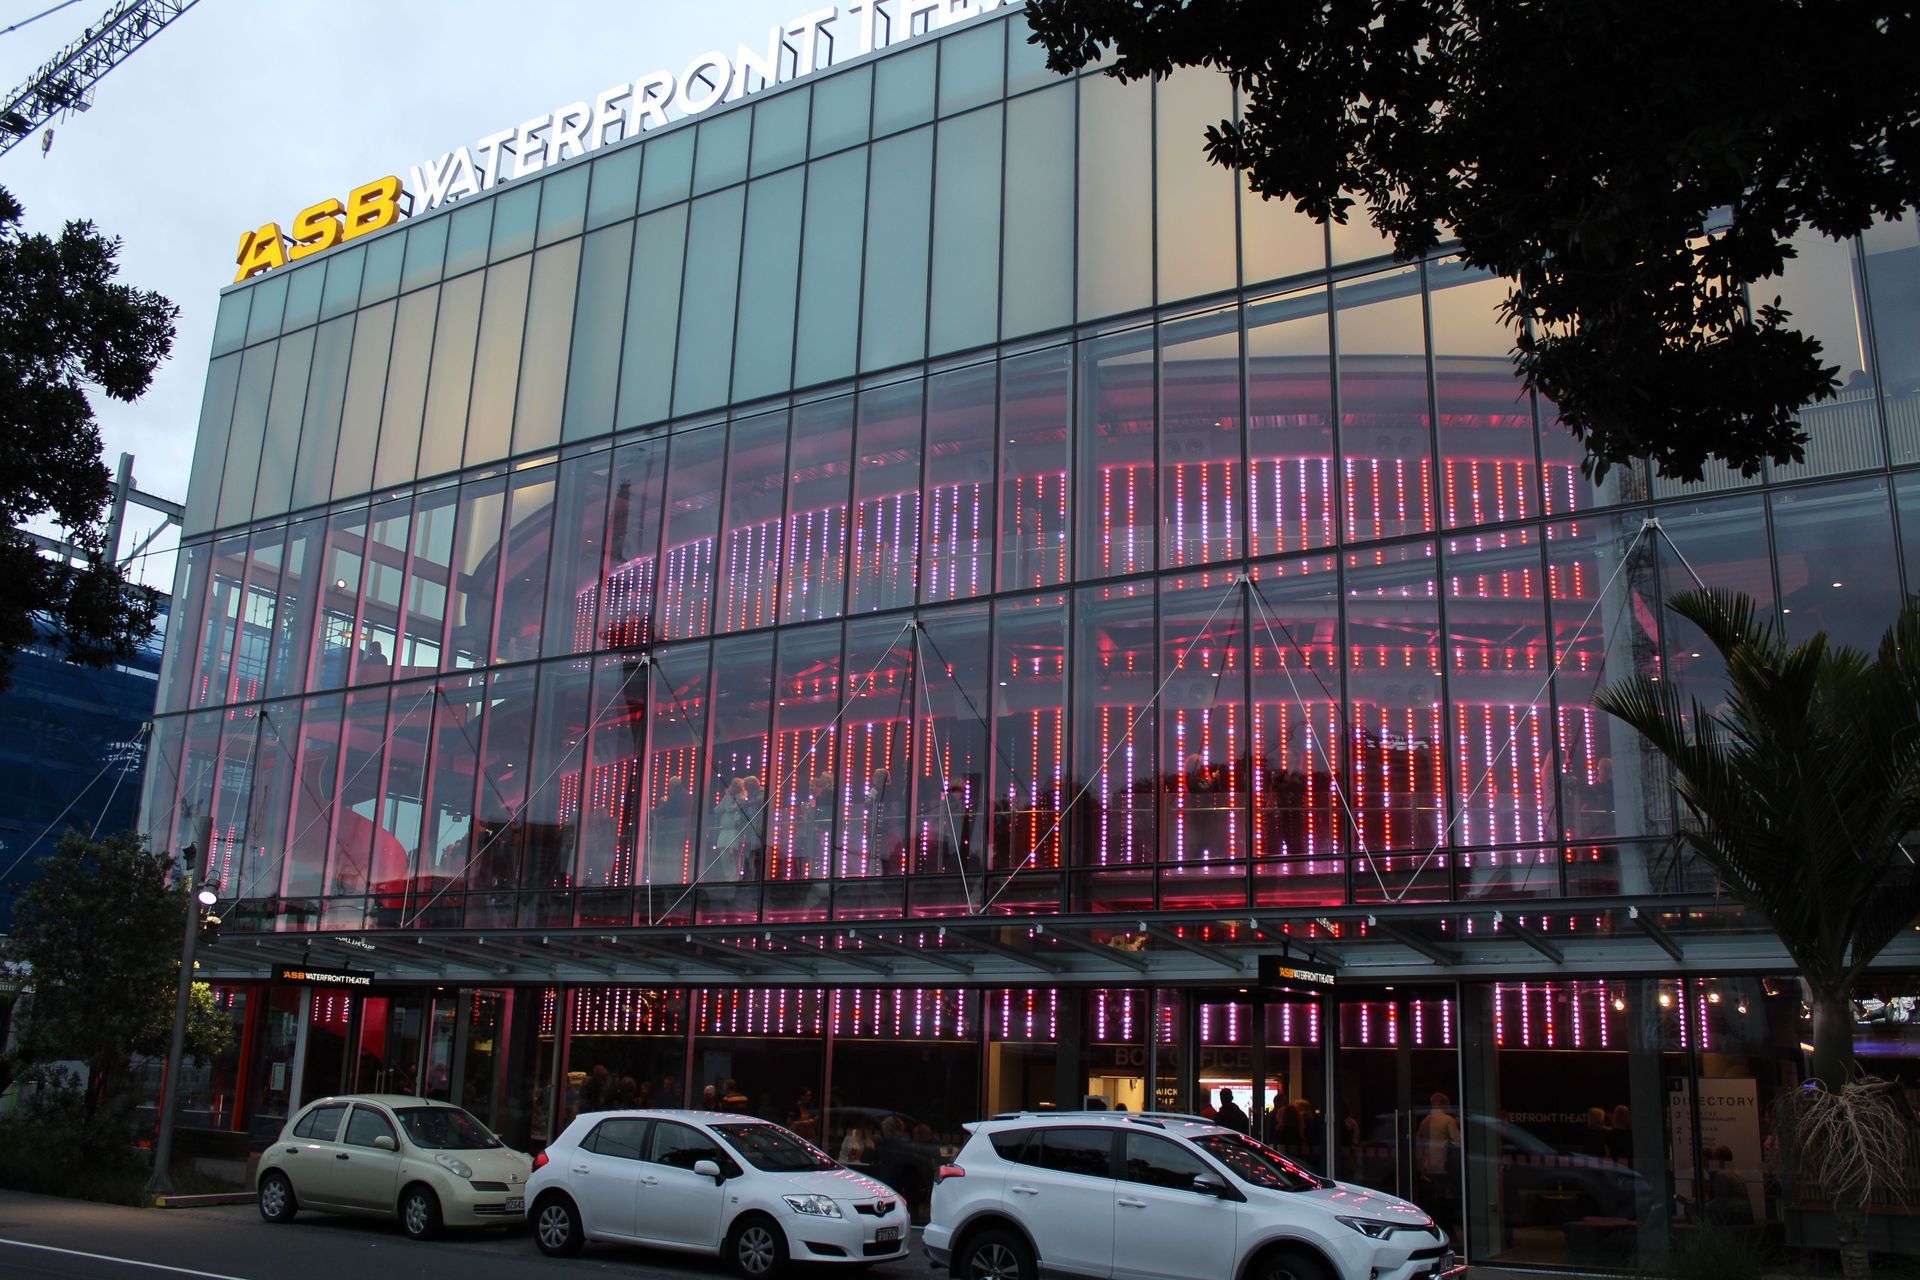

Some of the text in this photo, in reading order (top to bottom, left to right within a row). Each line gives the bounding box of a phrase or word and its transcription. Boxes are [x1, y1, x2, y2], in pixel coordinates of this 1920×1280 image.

[234, 175, 401, 283] ASB
[410, 5, 838, 212] WATERFRONT
[283, 970, 370, 985] ASB WATERFRONT THEATRE
[1279, 966, 1335, 985] ASB WATERFRONT THEATRE
[1673, 1096, 1754, 1106] DIECTORY
[1559, 1113, 1587, 1124] THEAT
